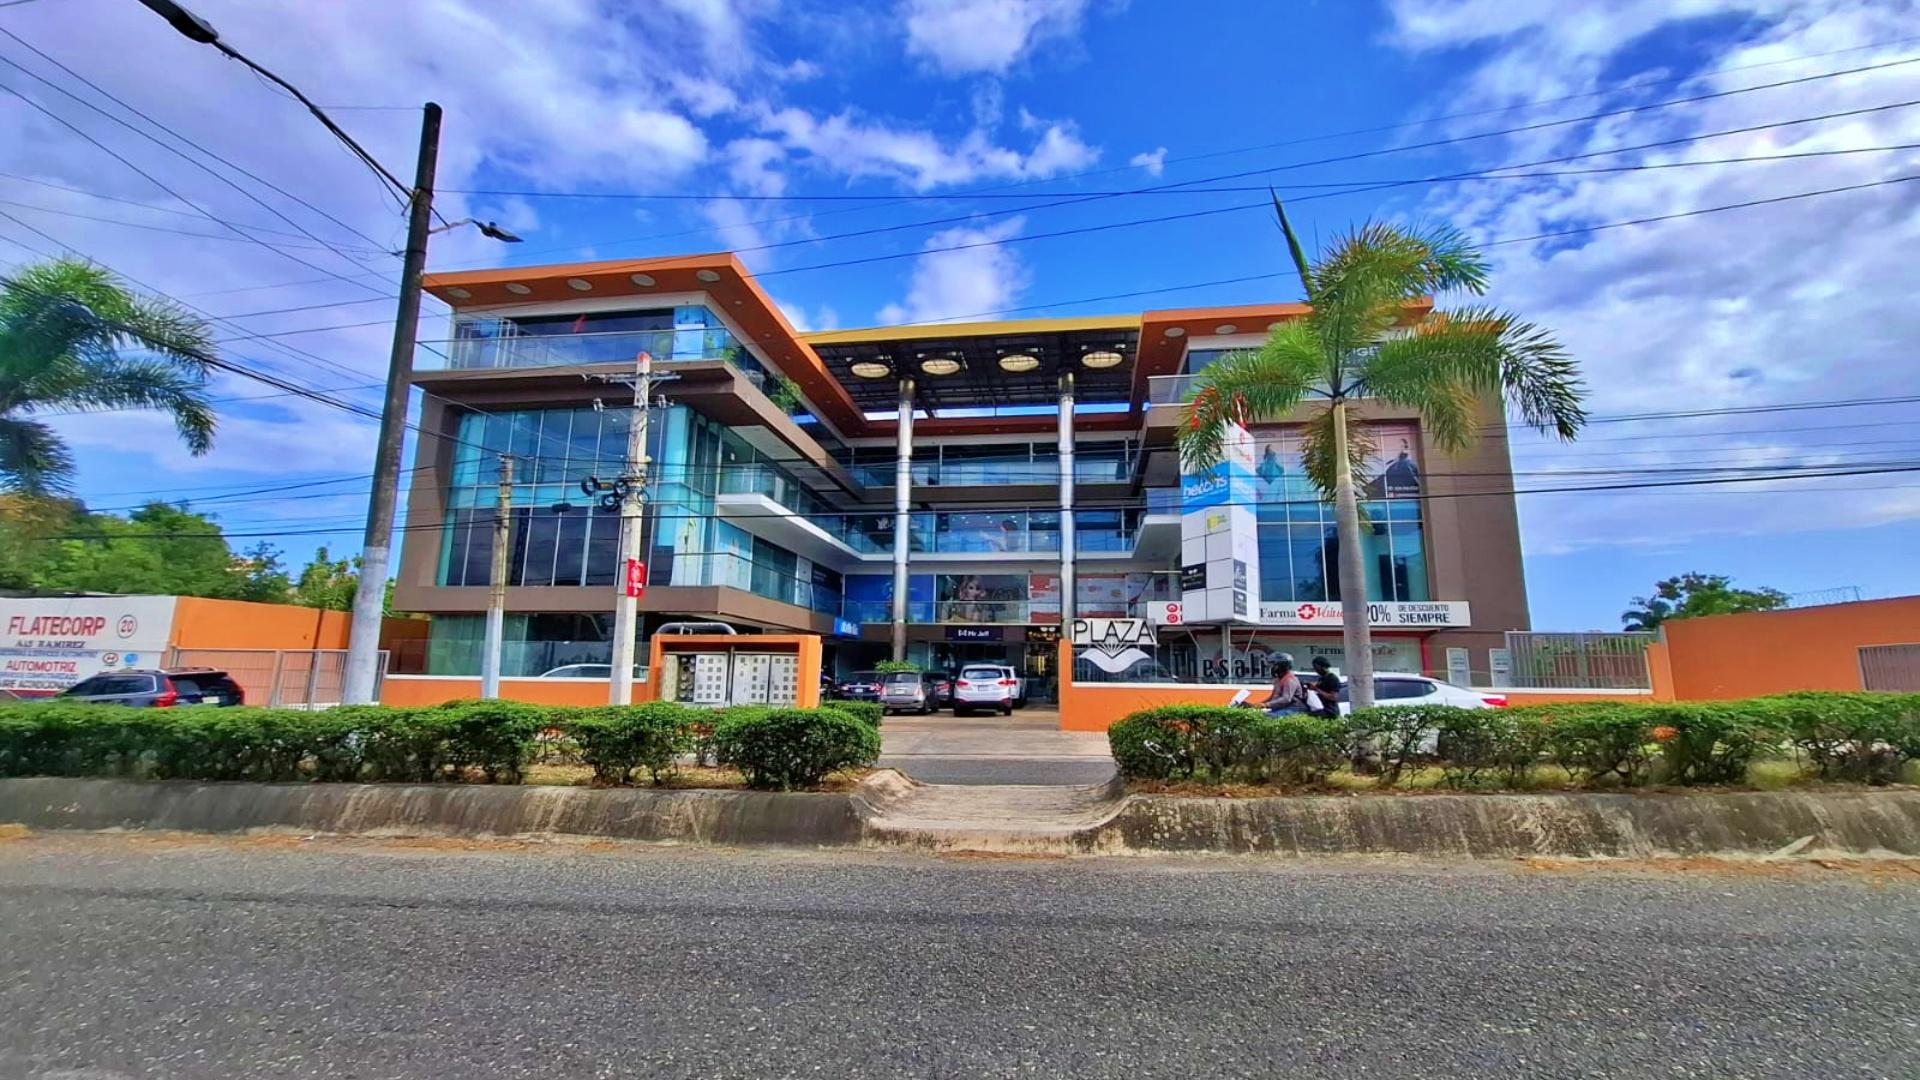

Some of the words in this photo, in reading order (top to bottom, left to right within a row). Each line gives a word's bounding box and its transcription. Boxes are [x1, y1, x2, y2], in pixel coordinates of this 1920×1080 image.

[1259, 608, 1297, 618] Farma
[1399, 613, 1451, 624] SIEMPRE
[8, 616, 106, 636] FLATECORP
[1073, 619, 1156, 643] PLAZA
[38, 640, 86, 649] RAMIREZ
[6, 660, 77, 672] AUTOMOTRIZ
